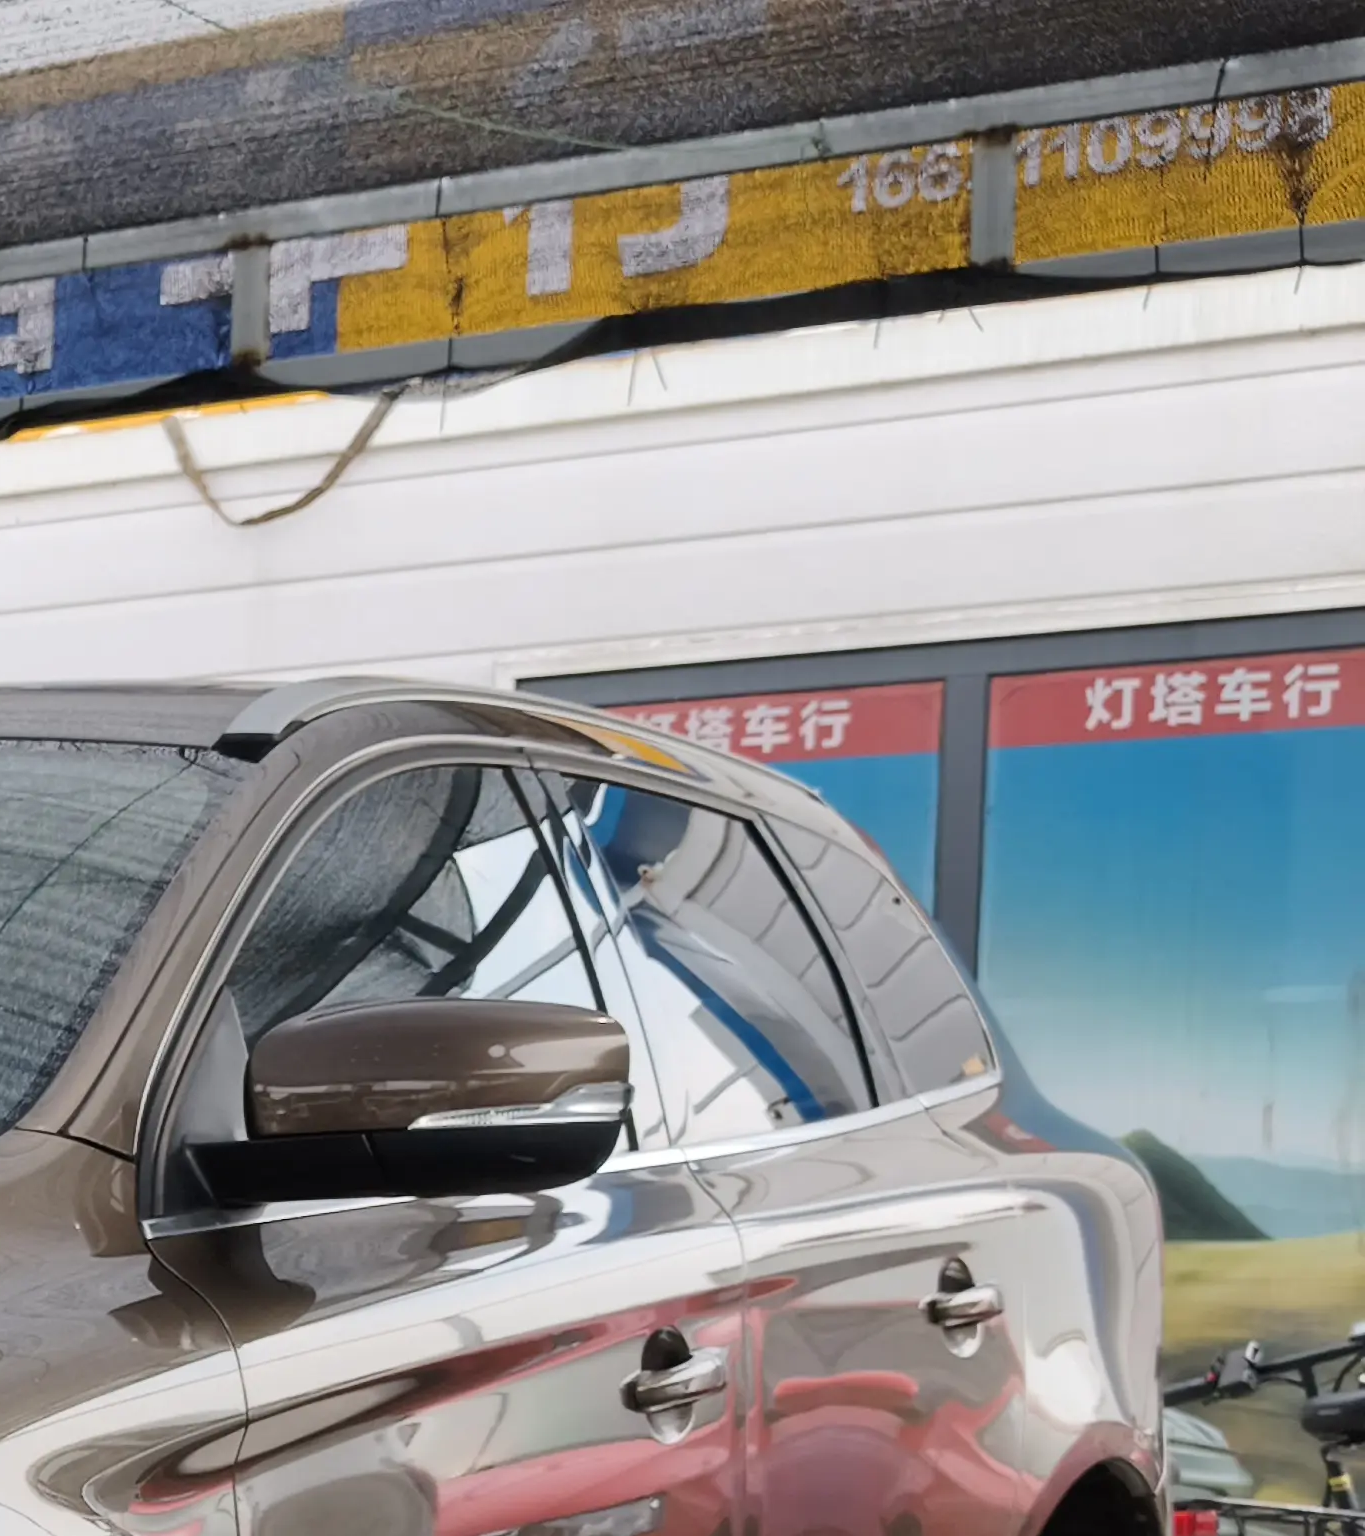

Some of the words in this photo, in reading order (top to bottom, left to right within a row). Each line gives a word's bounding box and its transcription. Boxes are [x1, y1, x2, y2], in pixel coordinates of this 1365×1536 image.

[836, 86, 1332, 214] 1661109999
[1084, 663, 1341, 731] 灯塔车行
